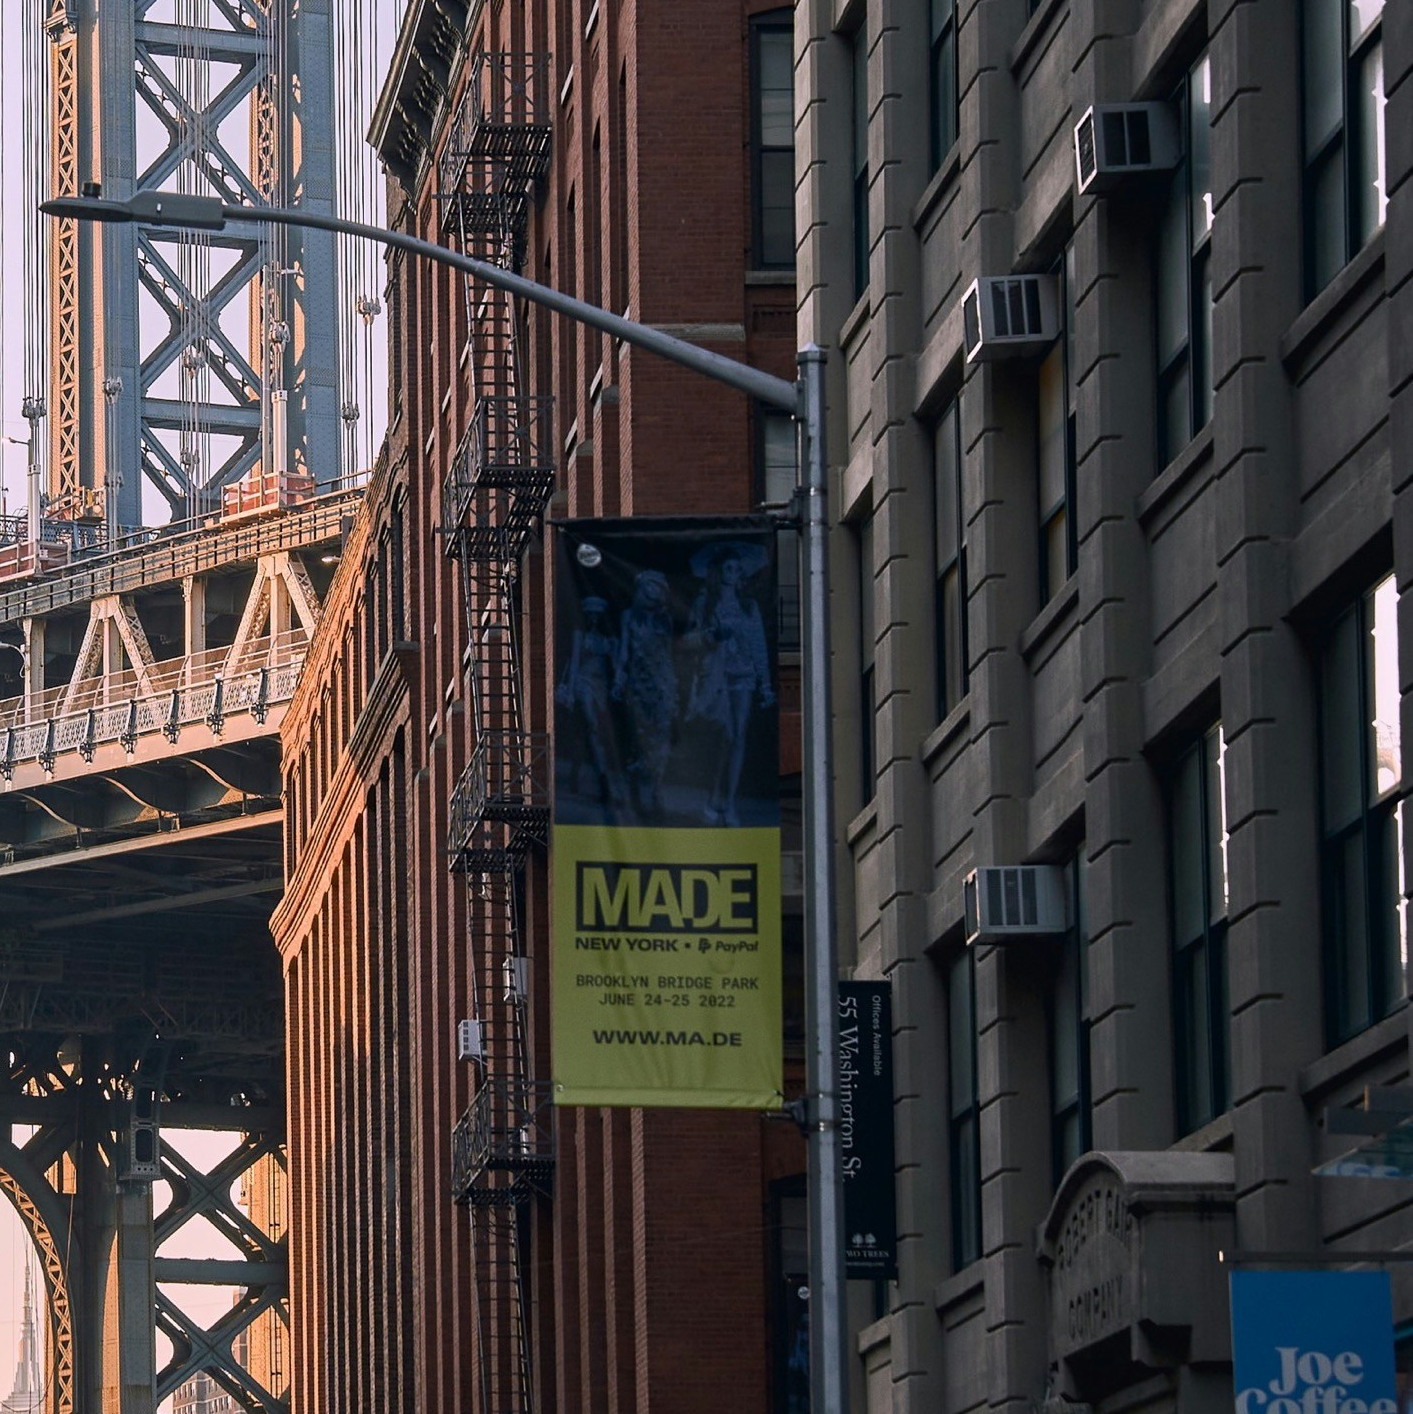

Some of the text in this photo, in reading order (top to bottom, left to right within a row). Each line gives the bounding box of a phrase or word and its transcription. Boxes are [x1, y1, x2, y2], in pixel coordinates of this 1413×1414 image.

[582, 866, 754, 929] MADE
[575, 937, 758, 954] NEW YORK PayPal
[576, 974, 759, 990] BROOKLYN BRIDGE PARK
[599, 992, 735, 1008] JUNE 24-25 2022
[592, 1030, 742, 1047] WWW.MA.DE
[871, 994, 883, 1077] Offices Available
[838, 995, 862, 1183] 55 Washington St.
[1058, 1189, 1101, 1271] ROBERT
[1069, 1274, 1123, 1340] COMPANY
[1268, 1346, 1364, 1395] Joe
